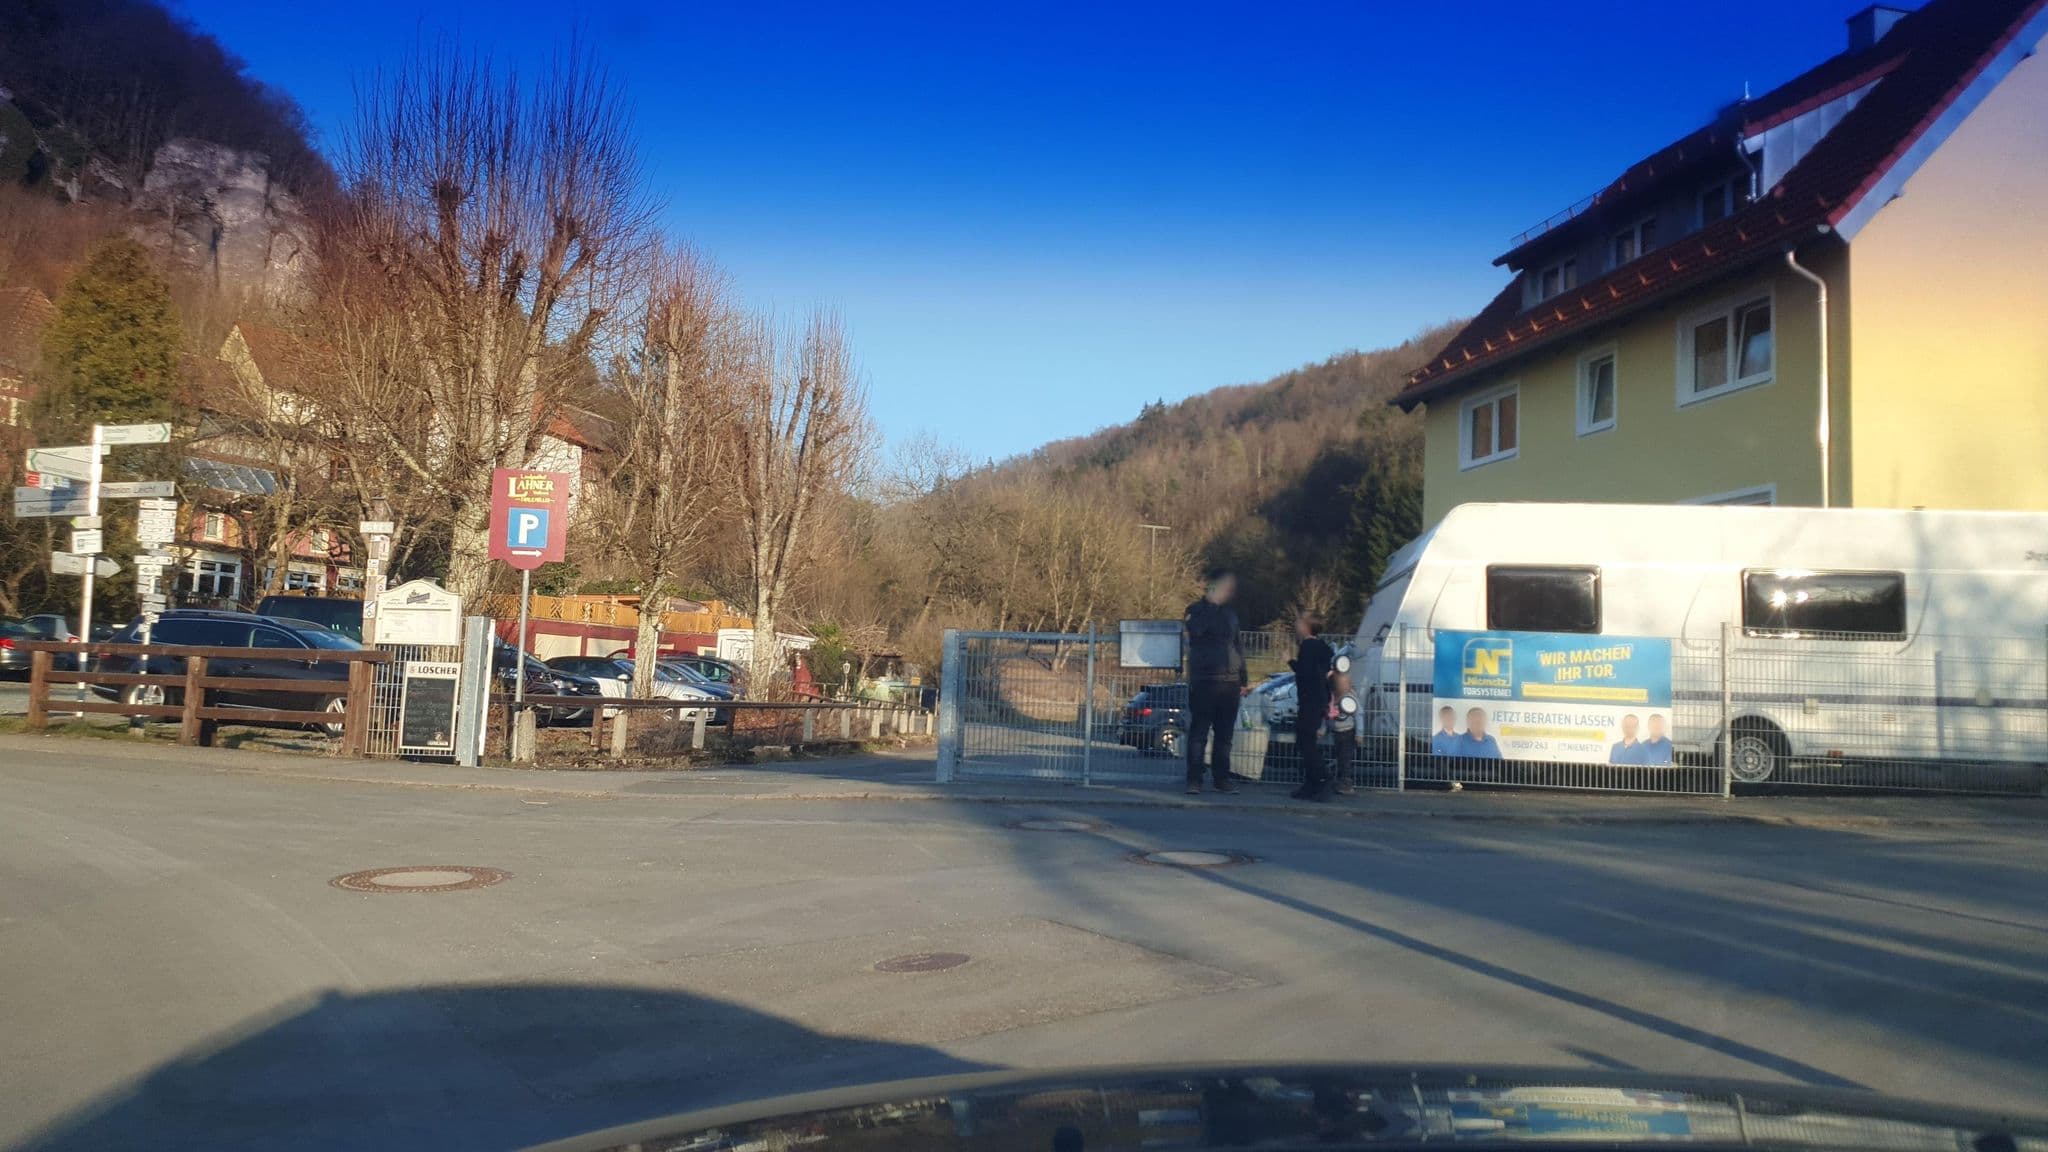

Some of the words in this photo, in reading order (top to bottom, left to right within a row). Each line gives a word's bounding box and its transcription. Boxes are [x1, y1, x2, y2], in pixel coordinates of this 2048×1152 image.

[507, 476, 555, 498] LAHNER
[518, 513, 540, 545] P
[1540, 651, 1567, 667] WIR
[1570, 646, 1632, 664] MACHEN
[1557, 666, 1582, 681] IHR
[1585, 663, 1614, 679] TOR
[1492, 711, 1521, 722] JETZT
[1523, 712, 1572, 725] BERATEN
[1574, 715, 1616, 727] LASSEN
